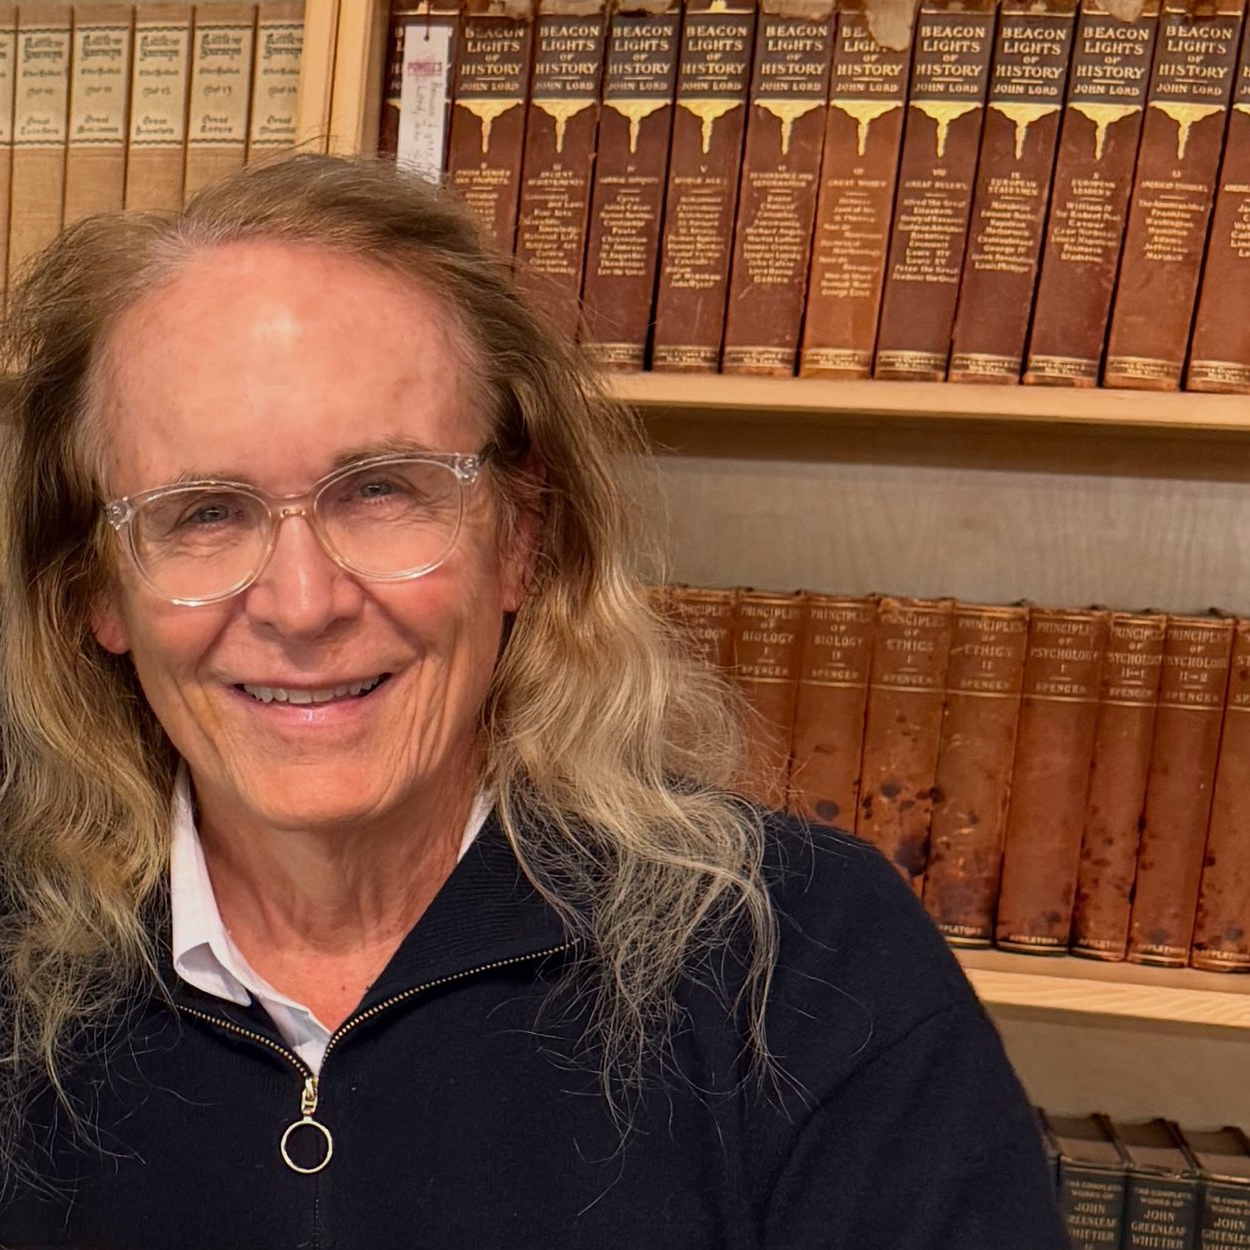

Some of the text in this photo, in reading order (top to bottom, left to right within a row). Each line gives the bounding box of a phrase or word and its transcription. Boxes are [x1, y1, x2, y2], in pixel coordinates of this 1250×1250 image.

[540, 26, 599, 37] BEACON
[612, 26, 673, 38] BEACON
[686, 26, 748, 37] BEACON
[766, 26, 828, 37] BEACON
[921, 26, 986, 39] BEACON
[1002, 27, 1067, 40] BEACON
[1083, 27, 1150, 41] BEACON
[1166, 26, 1232, 40] BEACON
[467, 41, 520, 52] LIGHTS
[542, 39, 595, 52] LIGHTS
[614, 39, 668, 52] LIGHTS
[688, 39, 742, 52] LIGHTS
[768, 39, 823, 52] LIGHTS
[923, 40, 980, 52] LIGHTS
[1004, 42, 1062, 55] LIGHTS
[1084, 42, 1144, 55] LIGHTS
[1168, 40, 1227, 54] LIGHTS
[485, 54, 500, 62] OF
[560, 53, 574, 62] OF
[632, 53, 648, 62] OF
[706, 53, 722, 62] OF
[786, 53, 802, 62] OF
[862, 54, 878, 62] OF
[942, 54, 958, 62] OF
[1022, 55, 1040, 64] OF
[1104, 56, 1121, 65] OF
[1188, 54, 1204, 64] OF
[461, 63, 522, 76] HISTORY
[535, 63, 598, 76] HISTORY
[608, 62, 670, 76] HISTORY
[681, 63, 745, 76] HISTORY
[761, 63, 826, 76] HISTORY
[836, 64, 903, 76] HISTORY
[916, 64, 982, 77] HISTORY
[996, 66, 1064, 79] HISTORY
[1076, 66, 1146, 80] HISTORY
[1158, 64, 1228, 78] HISTORY
[460, 82, 520, 92] JOHN LORD
[534, 81, 594, 92] JOHN LORD
[608, 82, 668, 92] JOHN LORD
[681, 82, 742, 92] JOHN LORD
[760, 82, 822, 92] JOHN LORD
[836, 82, 898, 93] JOHN LORD
[914, 82, 978, 94] JOHN LORD
[994, 84, 1058, 96] JOHN LORD
[1074, 84, 1140, 96] JOHN LORD
[1156, 83, 1222, 96] JOHN LORD
[742, 632, 794, 644] BIOLOGY
[814, 634, 863, 648] BIOLOGY
[886, 638, 934, 652] ETHICS
[964, 645, 1012, 658] ETHICS
[1074, 1202, 1106, 1214] JOHN
[1143, 1210, 1175, 1222] JOHN
[1131, 1222, 1186, 1235] GREENLEAF
[1214, 1217, 1246, 1230] JOHN
[1132, 1235, 1184, 1249] WHITTIER
